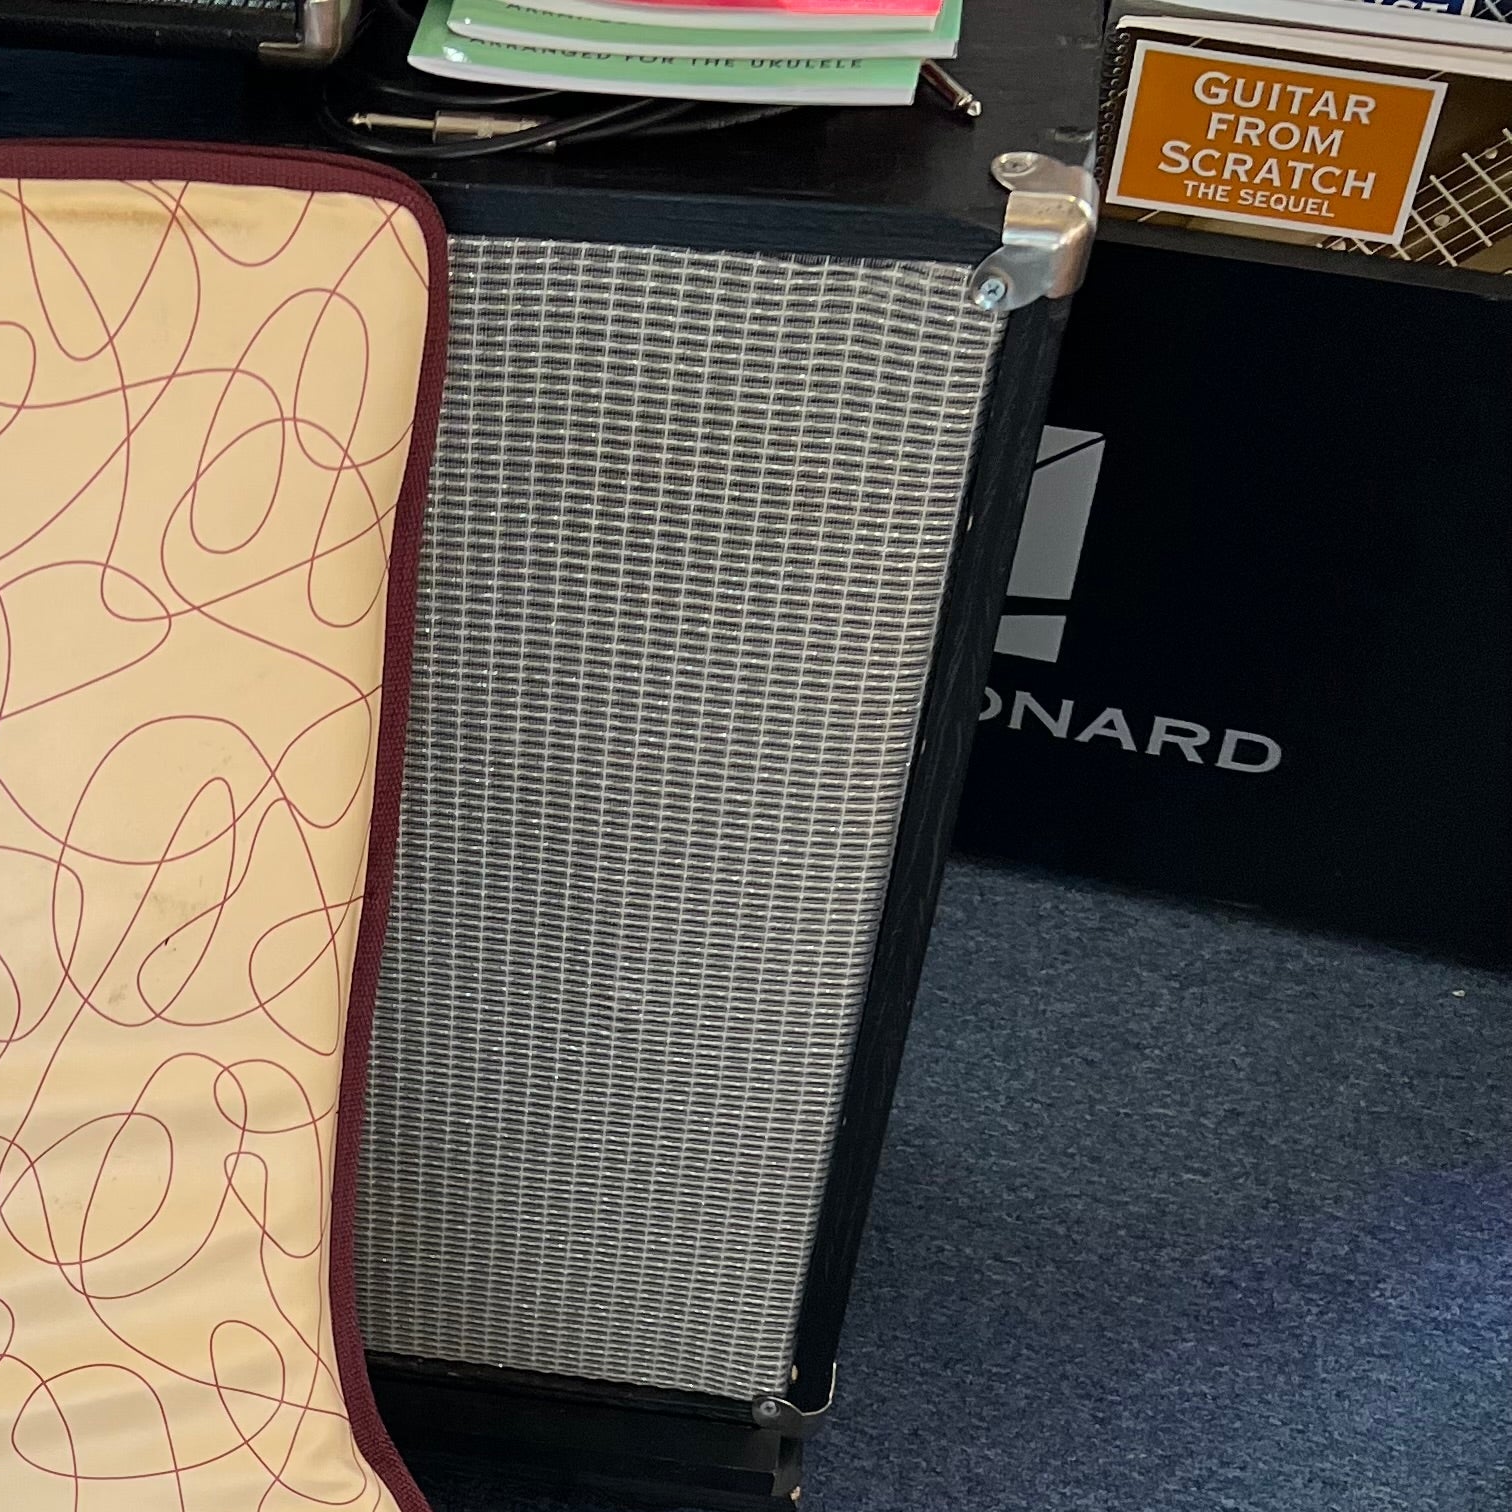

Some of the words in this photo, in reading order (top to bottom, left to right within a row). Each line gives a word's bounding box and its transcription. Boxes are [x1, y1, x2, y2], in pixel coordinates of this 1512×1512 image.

[750, 58, 865, 69] UKULELE
[1193, 70, 1377, 125] GUITAR
[1206, 112, 1343, 157] FROM
[1158, 141, 1376, 199] SCRATCH
[1184, 180, 1232, 204] THE
[1237, 188, 1335, 218] SEQUEL
